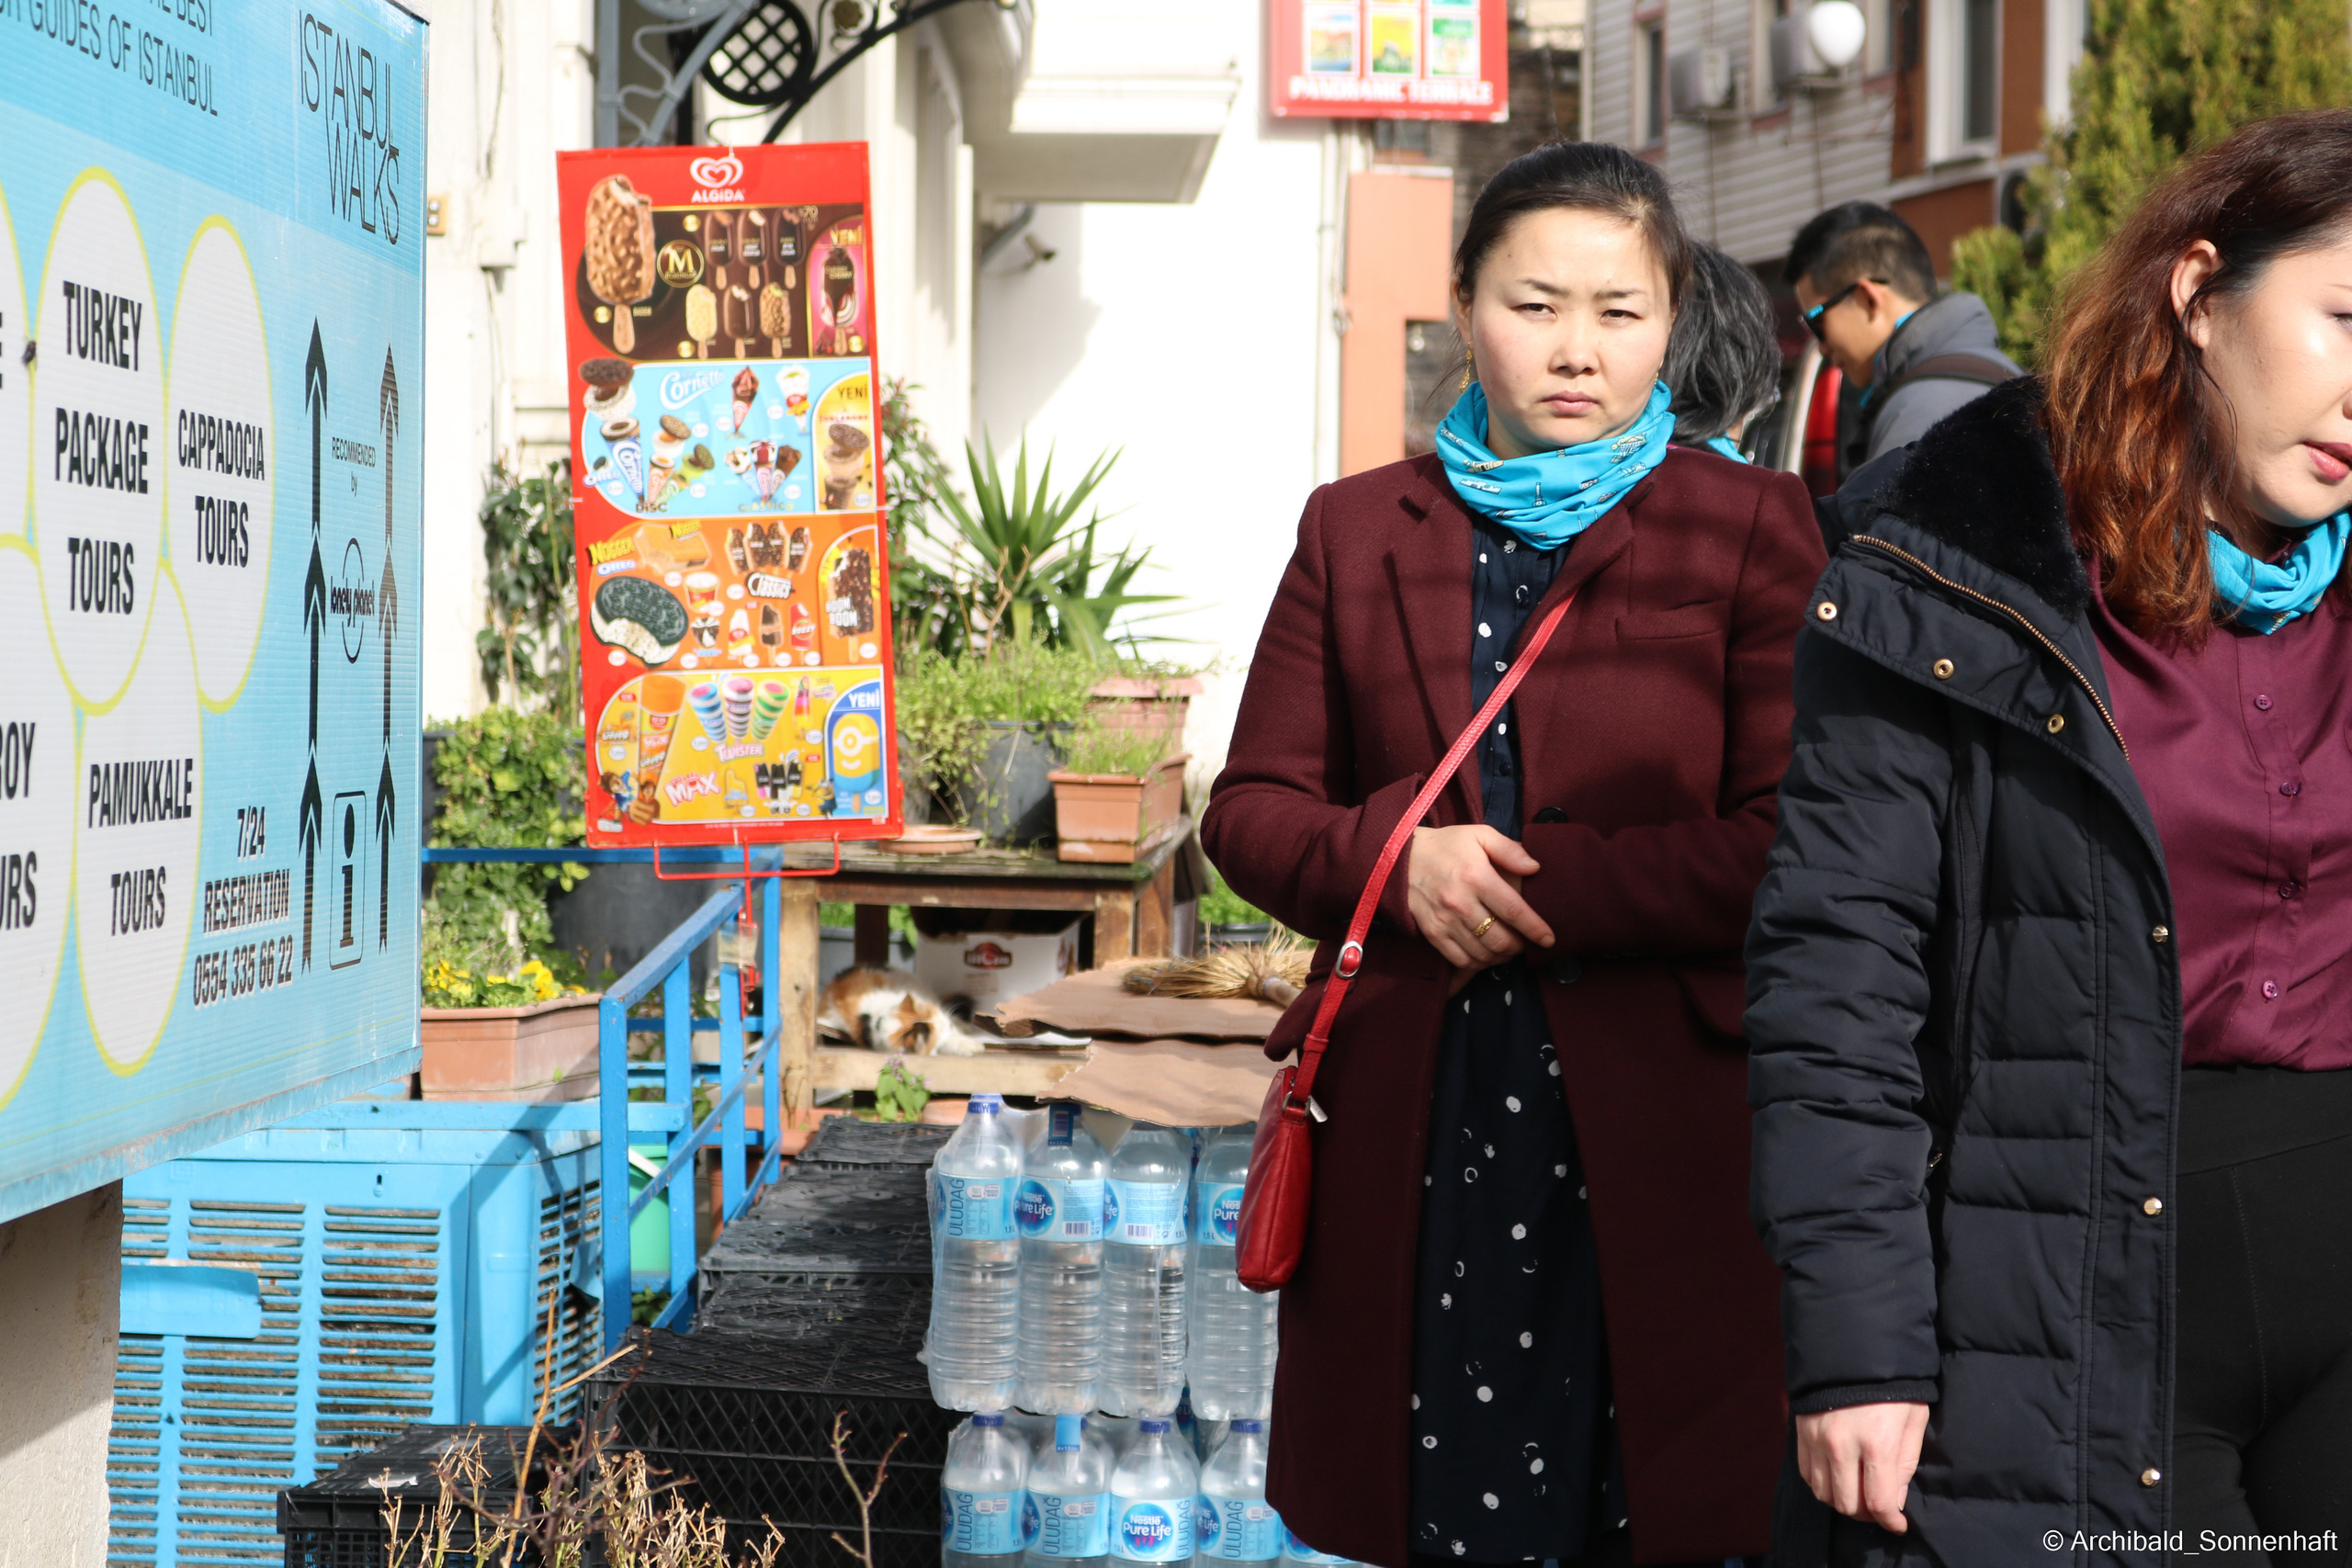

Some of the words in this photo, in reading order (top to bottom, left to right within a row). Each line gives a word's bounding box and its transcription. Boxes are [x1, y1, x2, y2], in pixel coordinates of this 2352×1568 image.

[107, 14, 130, 73] OF
[139, 28, 218, 117] ISTANBUL
[300, 10, 399, 151] ISTANBUL
[325, 122, 400, 244] WALKS
[63, 280, 142, 372] TURKEY
[660, 370, 726, 410] Cornetto
[54, 407, 149, 495] PACKAGE
[178, 409, 266, 480] CAPPADOCIA
[332, 437, 376, 468] RECOMMENDED
[351, 470, 358, 497] by
[195, 495, 249, 568] TOURS
[68, 537, 134, 615] TOURS
[331, 576, 352, 627] lonely
[353, 579, 375, 628] planet
[597, 560, 636, 576] OREO
[0, 721, 36, 800] OY
[88, 758, 193, 829] PAMUKKALE
[237, 806, 266, 860] 7/24
[110, 866, 166, 936] TOURS
[203, 868, 290, 935] RESERVATION
[193, 950, 228, 1008] 0554
[232, 943, 256, 998] 335
[259, 938, 275, 990] 66
[277, 933, 293, 986] 22
[1035, 1203, 1053, 1220] Life
[1222, 1200, 1240, 1210] Nes
[1123, 1522, 1149, 1536] Pure
[1151, 1525, 1171, 1540] Life
